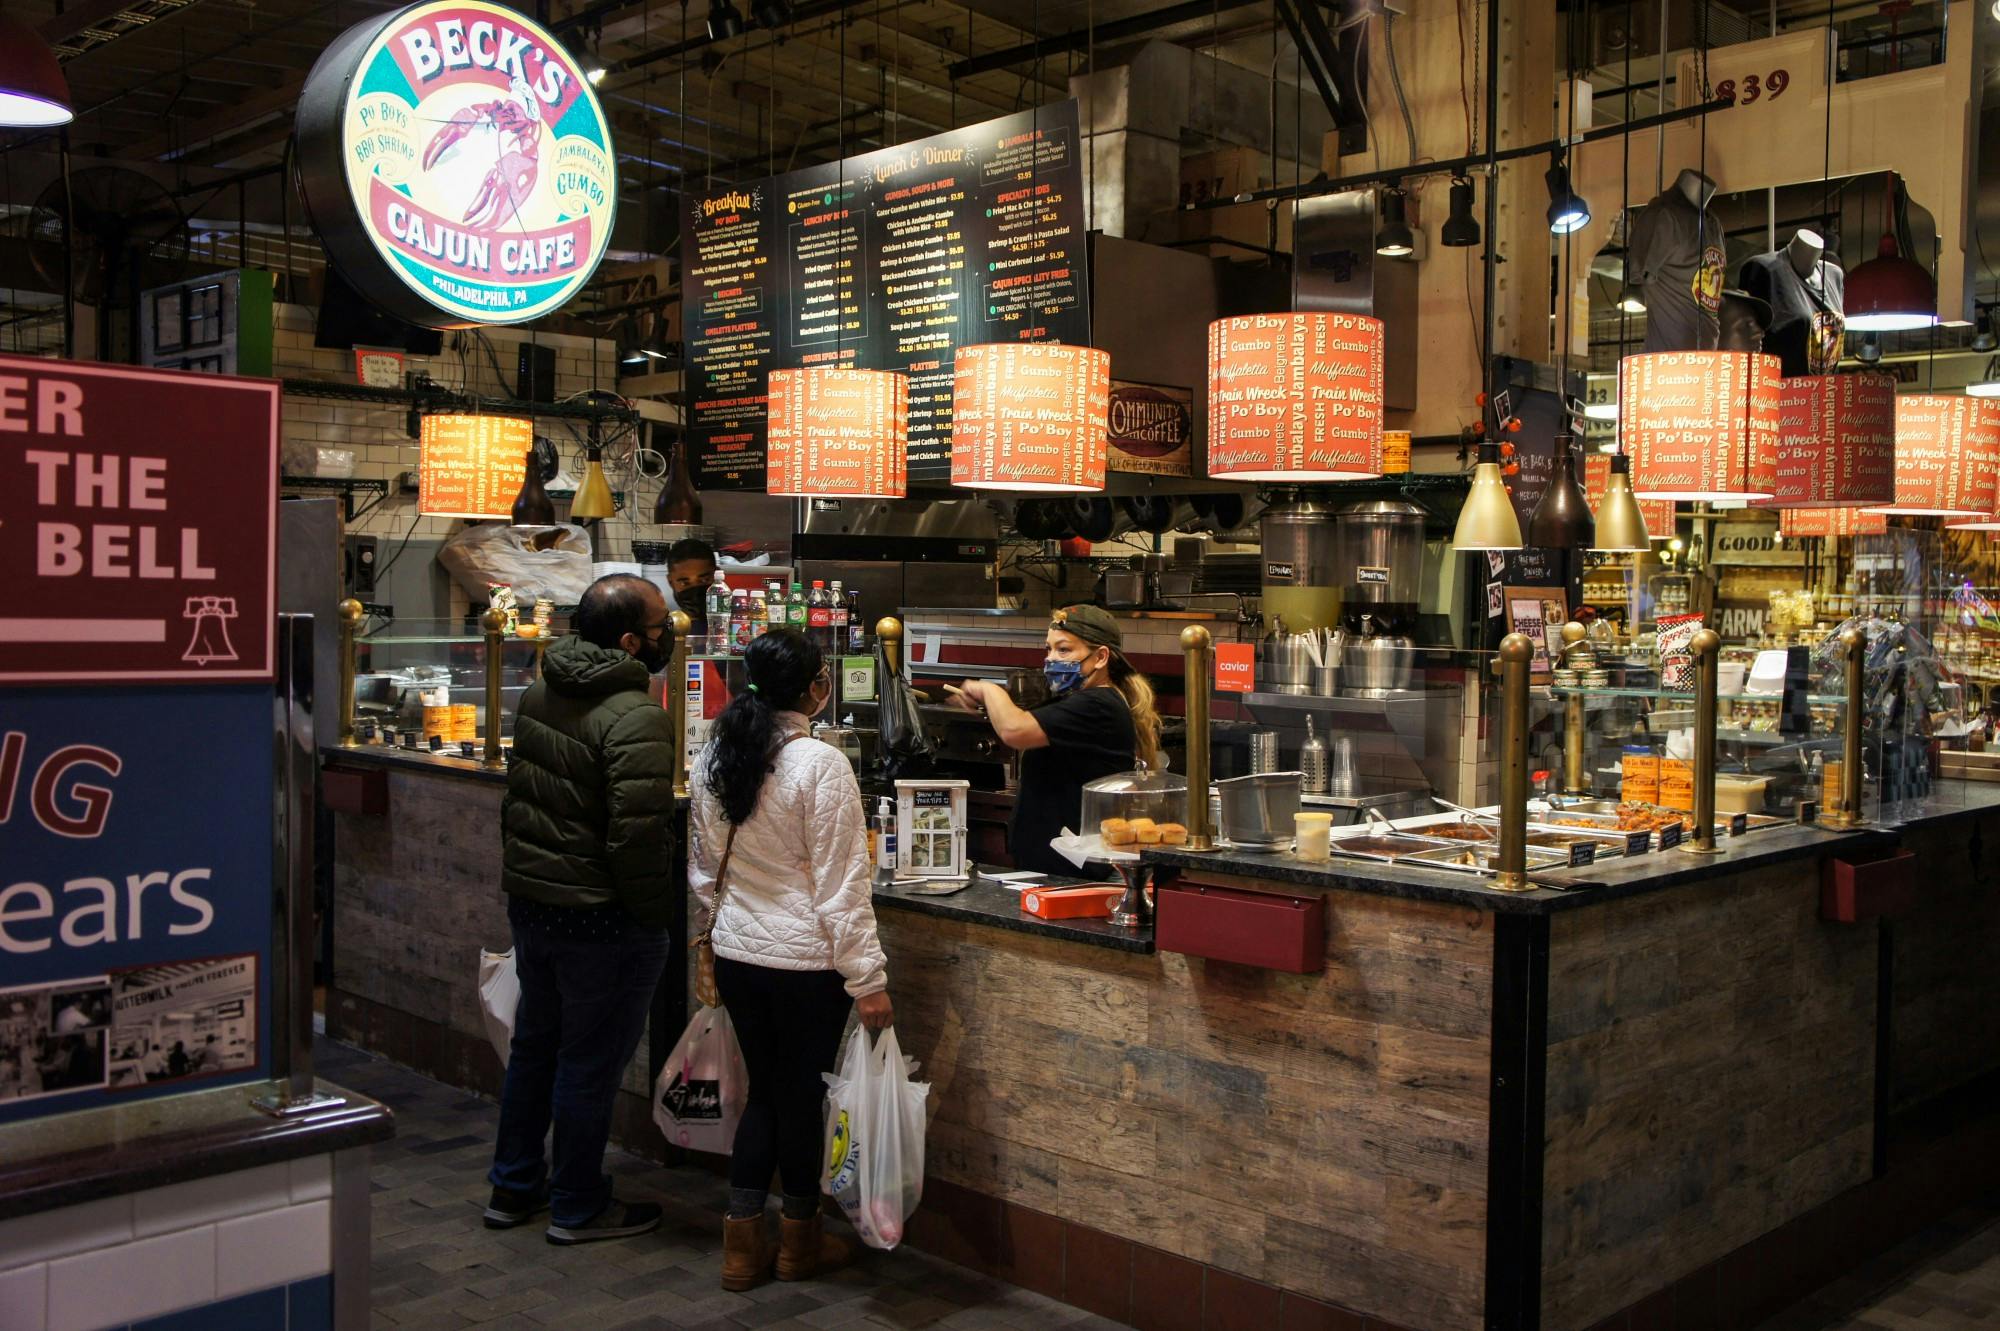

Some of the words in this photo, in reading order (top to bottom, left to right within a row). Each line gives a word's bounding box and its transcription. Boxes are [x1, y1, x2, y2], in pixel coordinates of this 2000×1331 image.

[400, 17, 570, 106] BECK'S
[381, 101, 409, 128] BOYS
[355, 138, 375, 163] BBQ
[378, 134, 415, 161] SHRIMP
[556, 144, 607, 175] JAMBALAYA
[911, 151, 919, 168] &
[923, 147, 963, 165] Dinner
[557, 173, 605, 207] GUMBO
[704, 192, 750, 216] Breakfast
[993, 207, 1006, 215] Fried
[804, 216, 822, 226] LUNCH
[387, 202, 490, 271] CAJUN
[500, 233, 575, 273] CAFE
[1039, 230, 1053, 238] Pasta
[1054, 226, 1070, 236] Salad
[805, 264, 817, 274] Fried
[432, 276, 512, 307] PHILADELPHIA,
[514, 290, 527, 305] PA
[804, 281, 816, 290] Fried
[806, 296, 818, 304] Fried
[1315, 314, 1326, 354] FRESH
[1231, 339, 1271, 352] Gumbo
[1332, 339, 1369, 353] Gumbo
[1274, 334, 1287, 384] Beignets
[1290, 315, 1308, 400] Jambalaya
[1020, 366, 1062, 377] Gumbo
[1739, 353, 1748, 390] FRESH
[985, 345, 1000, 420] Jambalaya
[1657, 375, 1700, 385] Gumbo
[1219, 389, 1244, 401] Train
[1246, 387, 1287, 400] Wreck
[1311, 386, 1347, 400] Train
[1350, 388, 1377, 404] Wreck
[1716, 353, 1734, 430] Jambalaya
[1000, 408, 1034, 419] Train
[1038, 408, 1074, 422] Wreck
[1823, 377, 1838, 444] Jambalaya
[1140, 418, 1181, 442] COFFEE
[1314, 403, 1326, 443] FRESH
[1640, 417, 1670, 429] Train
[1673, 416, 1714, 429] Wreck
[840, 427, 873, 438] Wreck
[1003, 422, 1012, 457] FRESH
[1230, 427, 1270, 438] Gumbo
[1332, 427, 1368, 439] Gumbo
[1785, 434, 1821, 446] Wreck
[809, 439, 818, 471] FRESH
[1018, 443, 1059, 455] Gumbo
[823, 459, 861, 468] Gumbo
[1655, 452, 1697, 463] Gumbo
[1844, 446, 1852, 478] FRESH
[26, 450, 167, 510] THE
[1896, 477, 1932, 486] Gumbo
[37, 522, 216, 579] BELL
[1719, 537, 1775, 551] GOOD
[1514, 618, 1542, 628] CHEESE
[1518, 628, 1541, 638] STEAK
[1220, 662, 1249, 672] caviar
[207, 963, 245, 981] FOREVER
